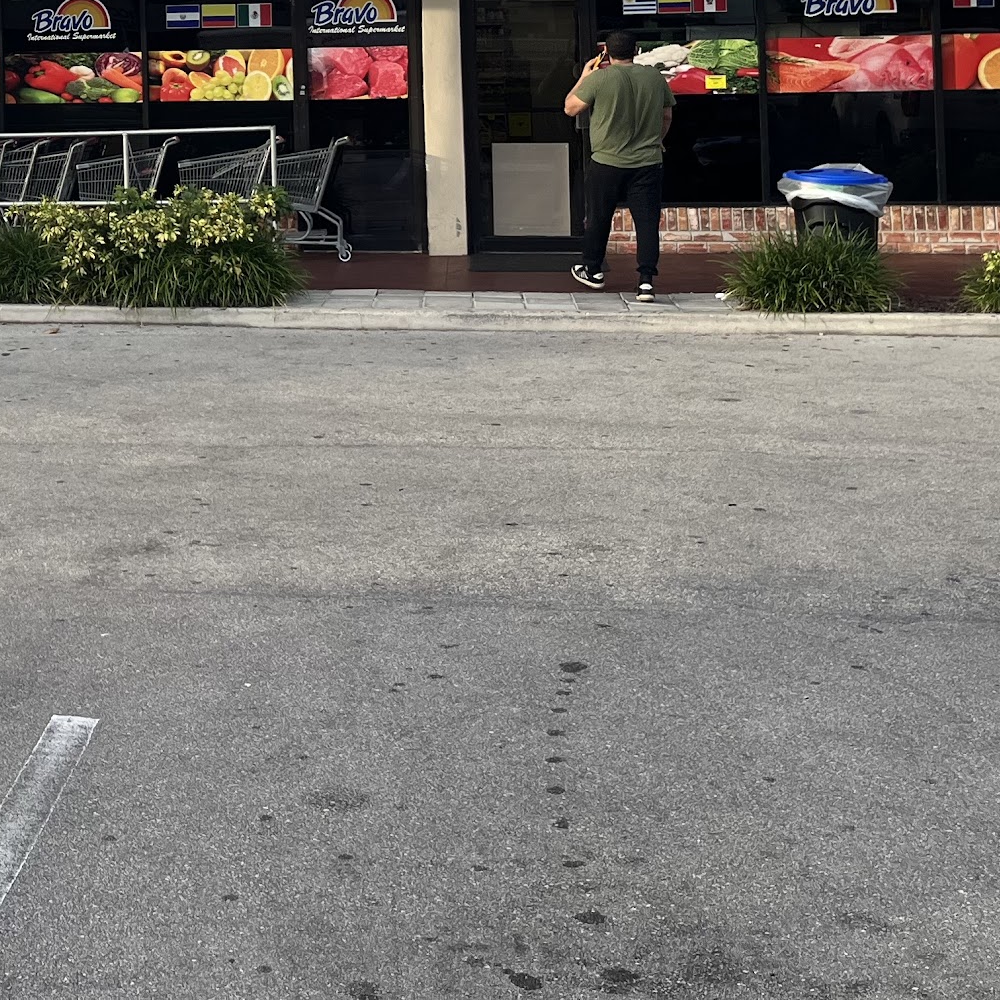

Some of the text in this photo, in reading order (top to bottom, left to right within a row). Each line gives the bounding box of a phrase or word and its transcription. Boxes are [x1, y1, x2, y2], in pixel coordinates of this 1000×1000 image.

[32, 8, 94, 33] Bravo
[311, 0, 378, 26] Bravo
[27, 31, 117, 41] International Supermarket
[308, 25, 406, 34] International Supermarket
